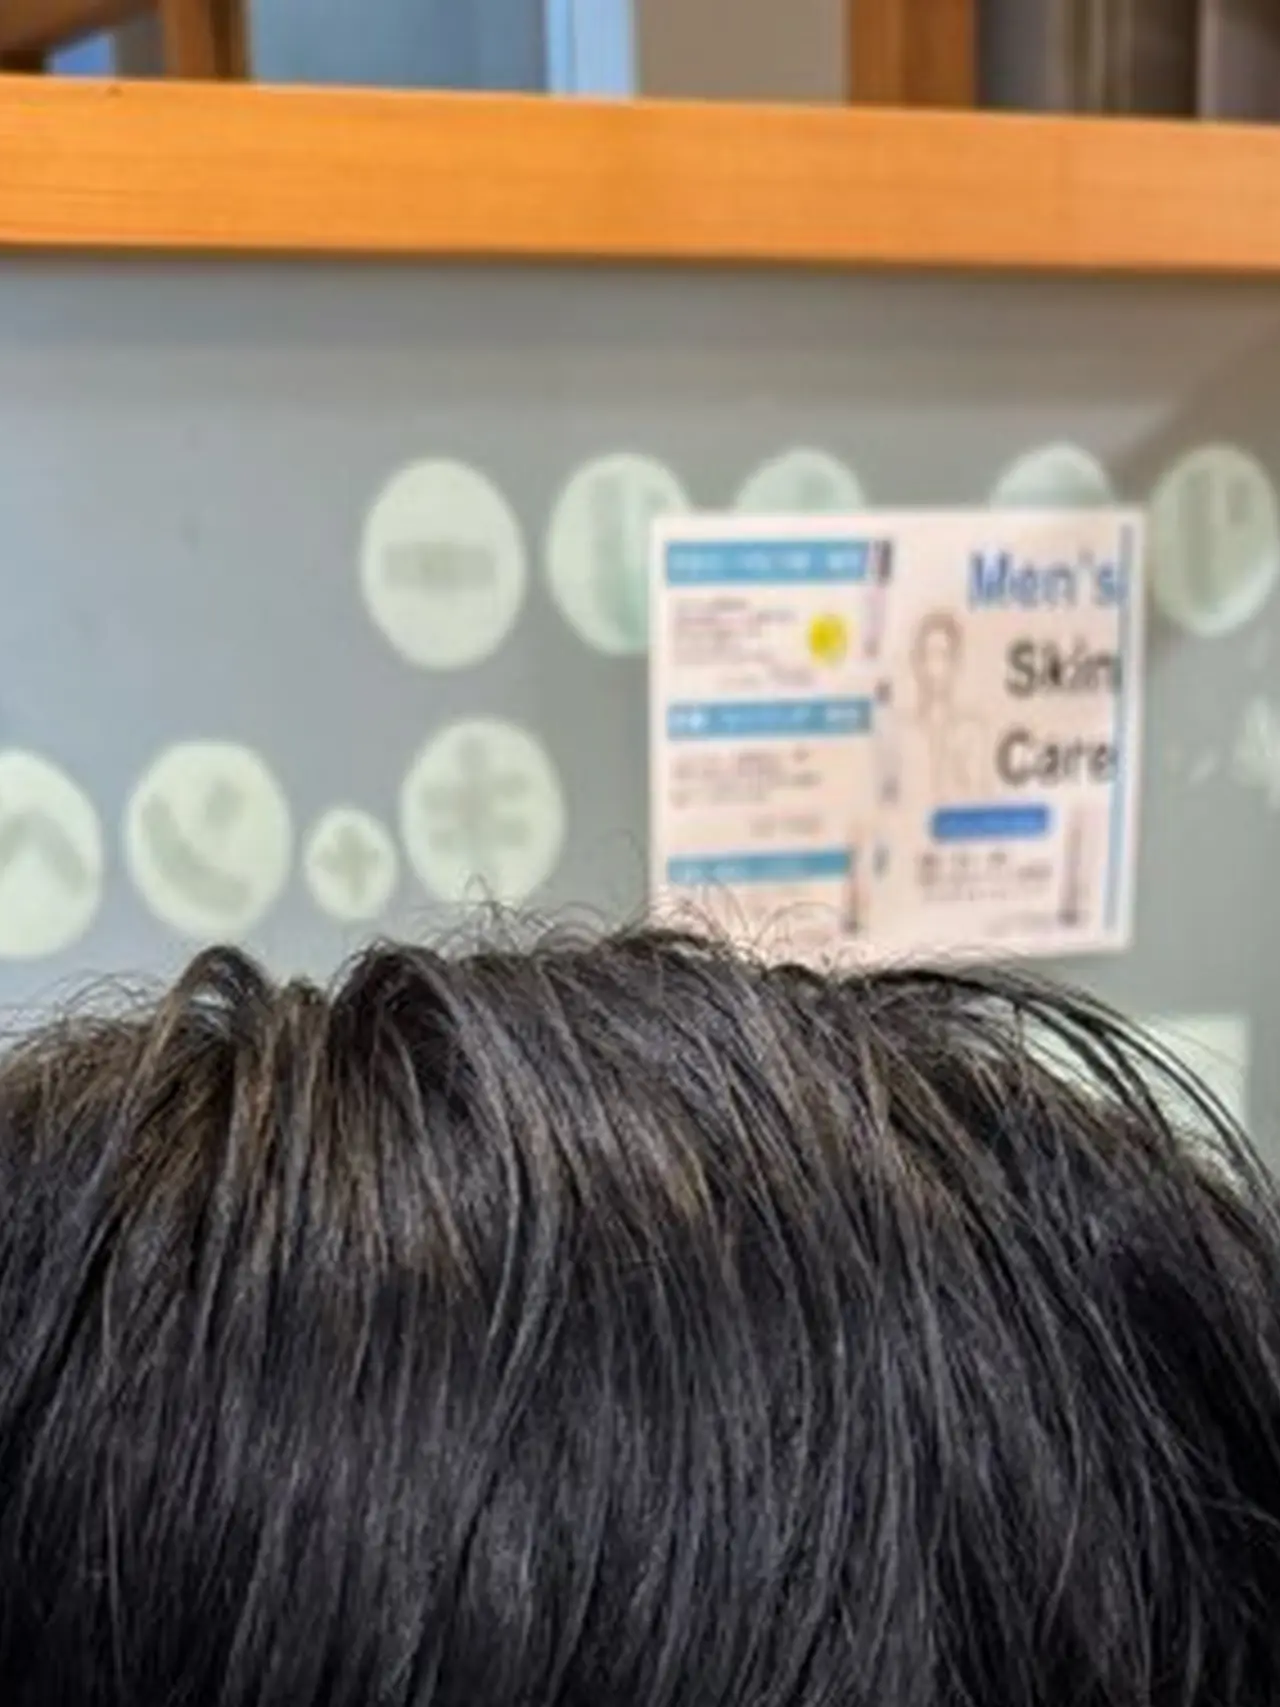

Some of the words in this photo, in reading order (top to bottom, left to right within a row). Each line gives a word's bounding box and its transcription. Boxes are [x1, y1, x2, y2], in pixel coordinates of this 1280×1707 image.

[969, 551, 1124, 609] Men's
[1005, 637, 1121, 698] Skin
[995, 728, 1120, 786] Care
